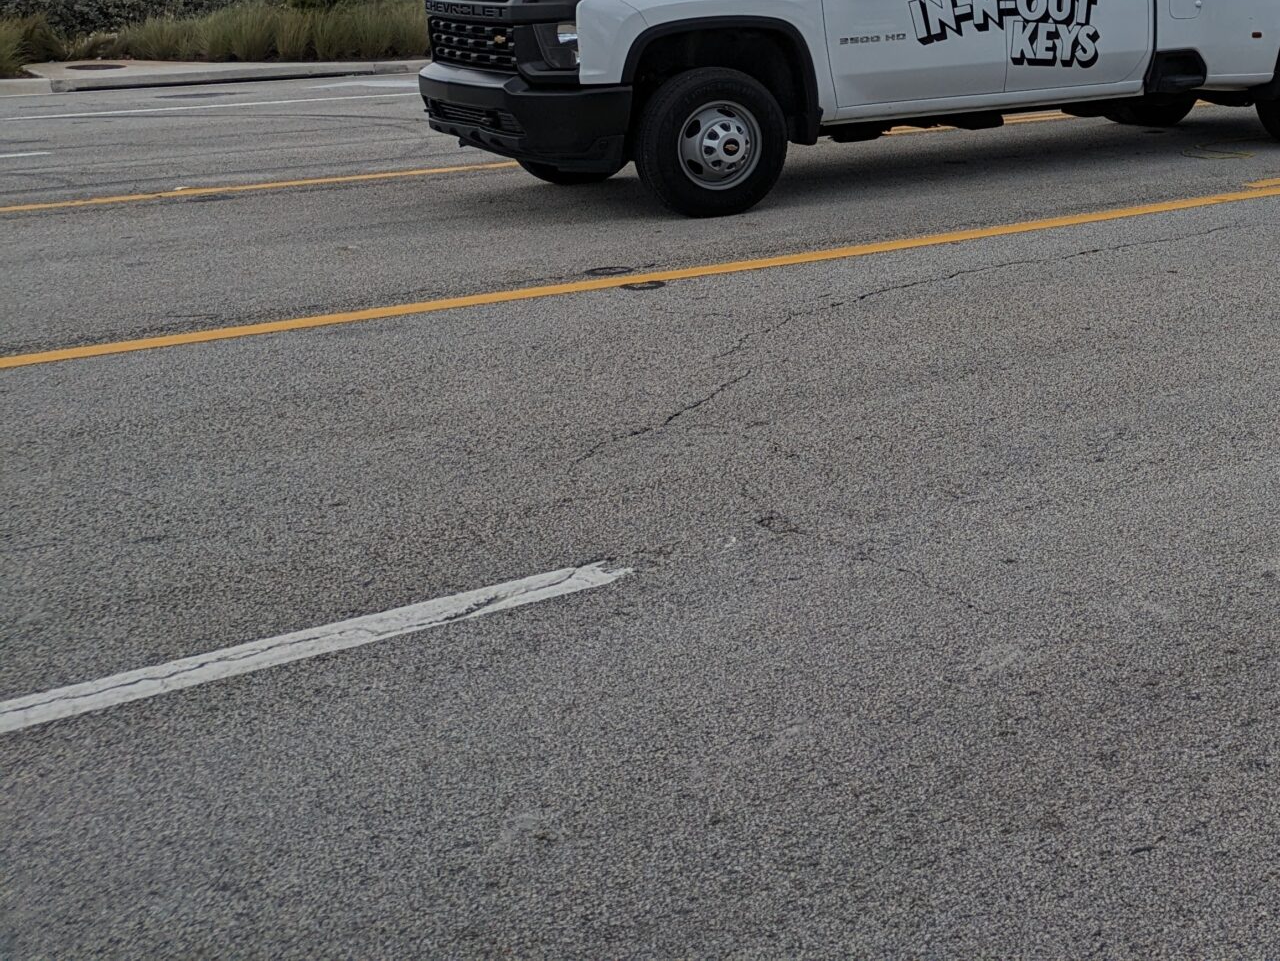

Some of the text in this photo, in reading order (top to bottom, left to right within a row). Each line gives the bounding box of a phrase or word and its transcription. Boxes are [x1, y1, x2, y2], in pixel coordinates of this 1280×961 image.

[425, 0, 507, 18] CHEVROLET
[885, 33, 907, 42] HD
[1010, 20, 1101, 69] KEYS
